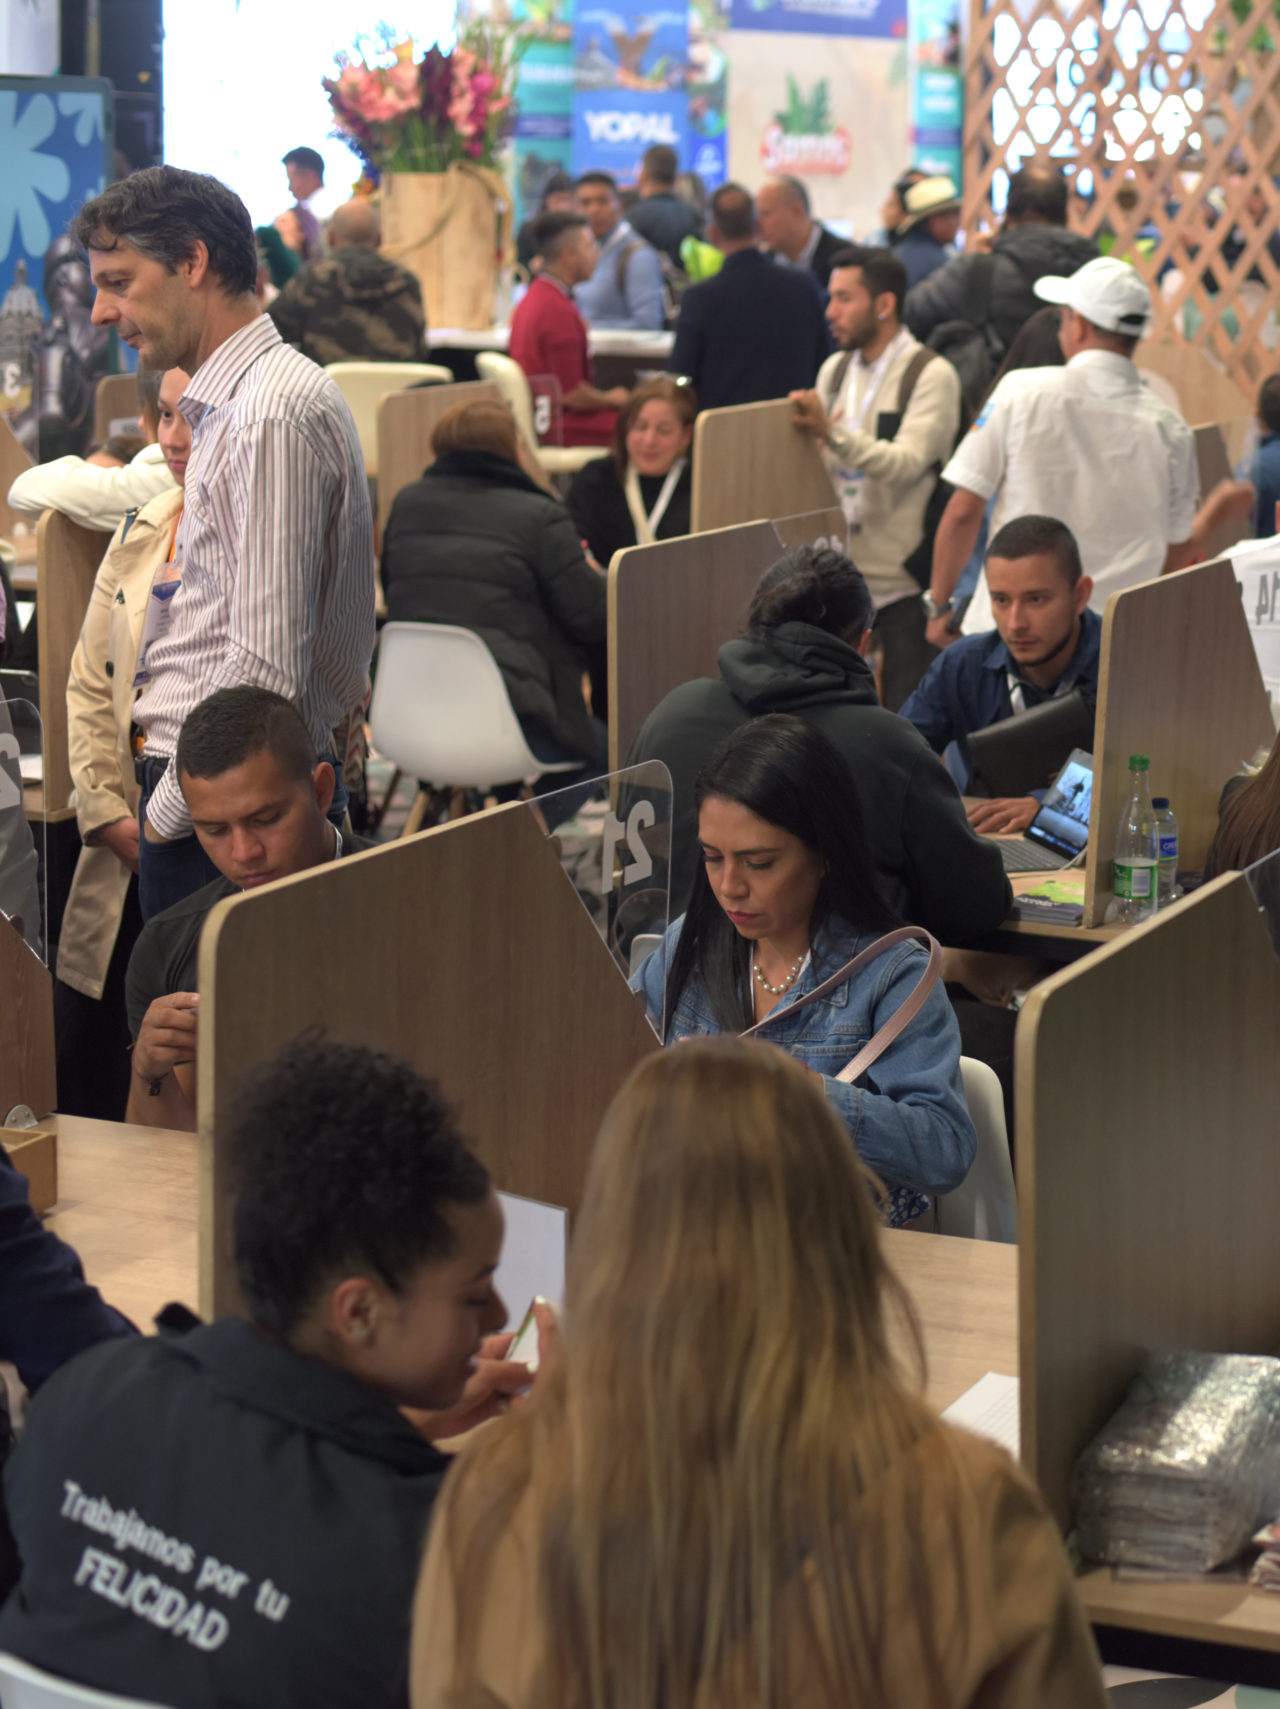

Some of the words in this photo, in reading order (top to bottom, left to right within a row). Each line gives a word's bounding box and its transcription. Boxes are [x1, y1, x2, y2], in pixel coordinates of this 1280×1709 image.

[583, 111, 681, 144] YOPAL
[60, 1478, 196, 1574] Trabajamos
[195, 1555, 249, 1600] por
[254, 1577, 291, 1623] tu
[73, 1545, 230, 1652] FELICIDAD
